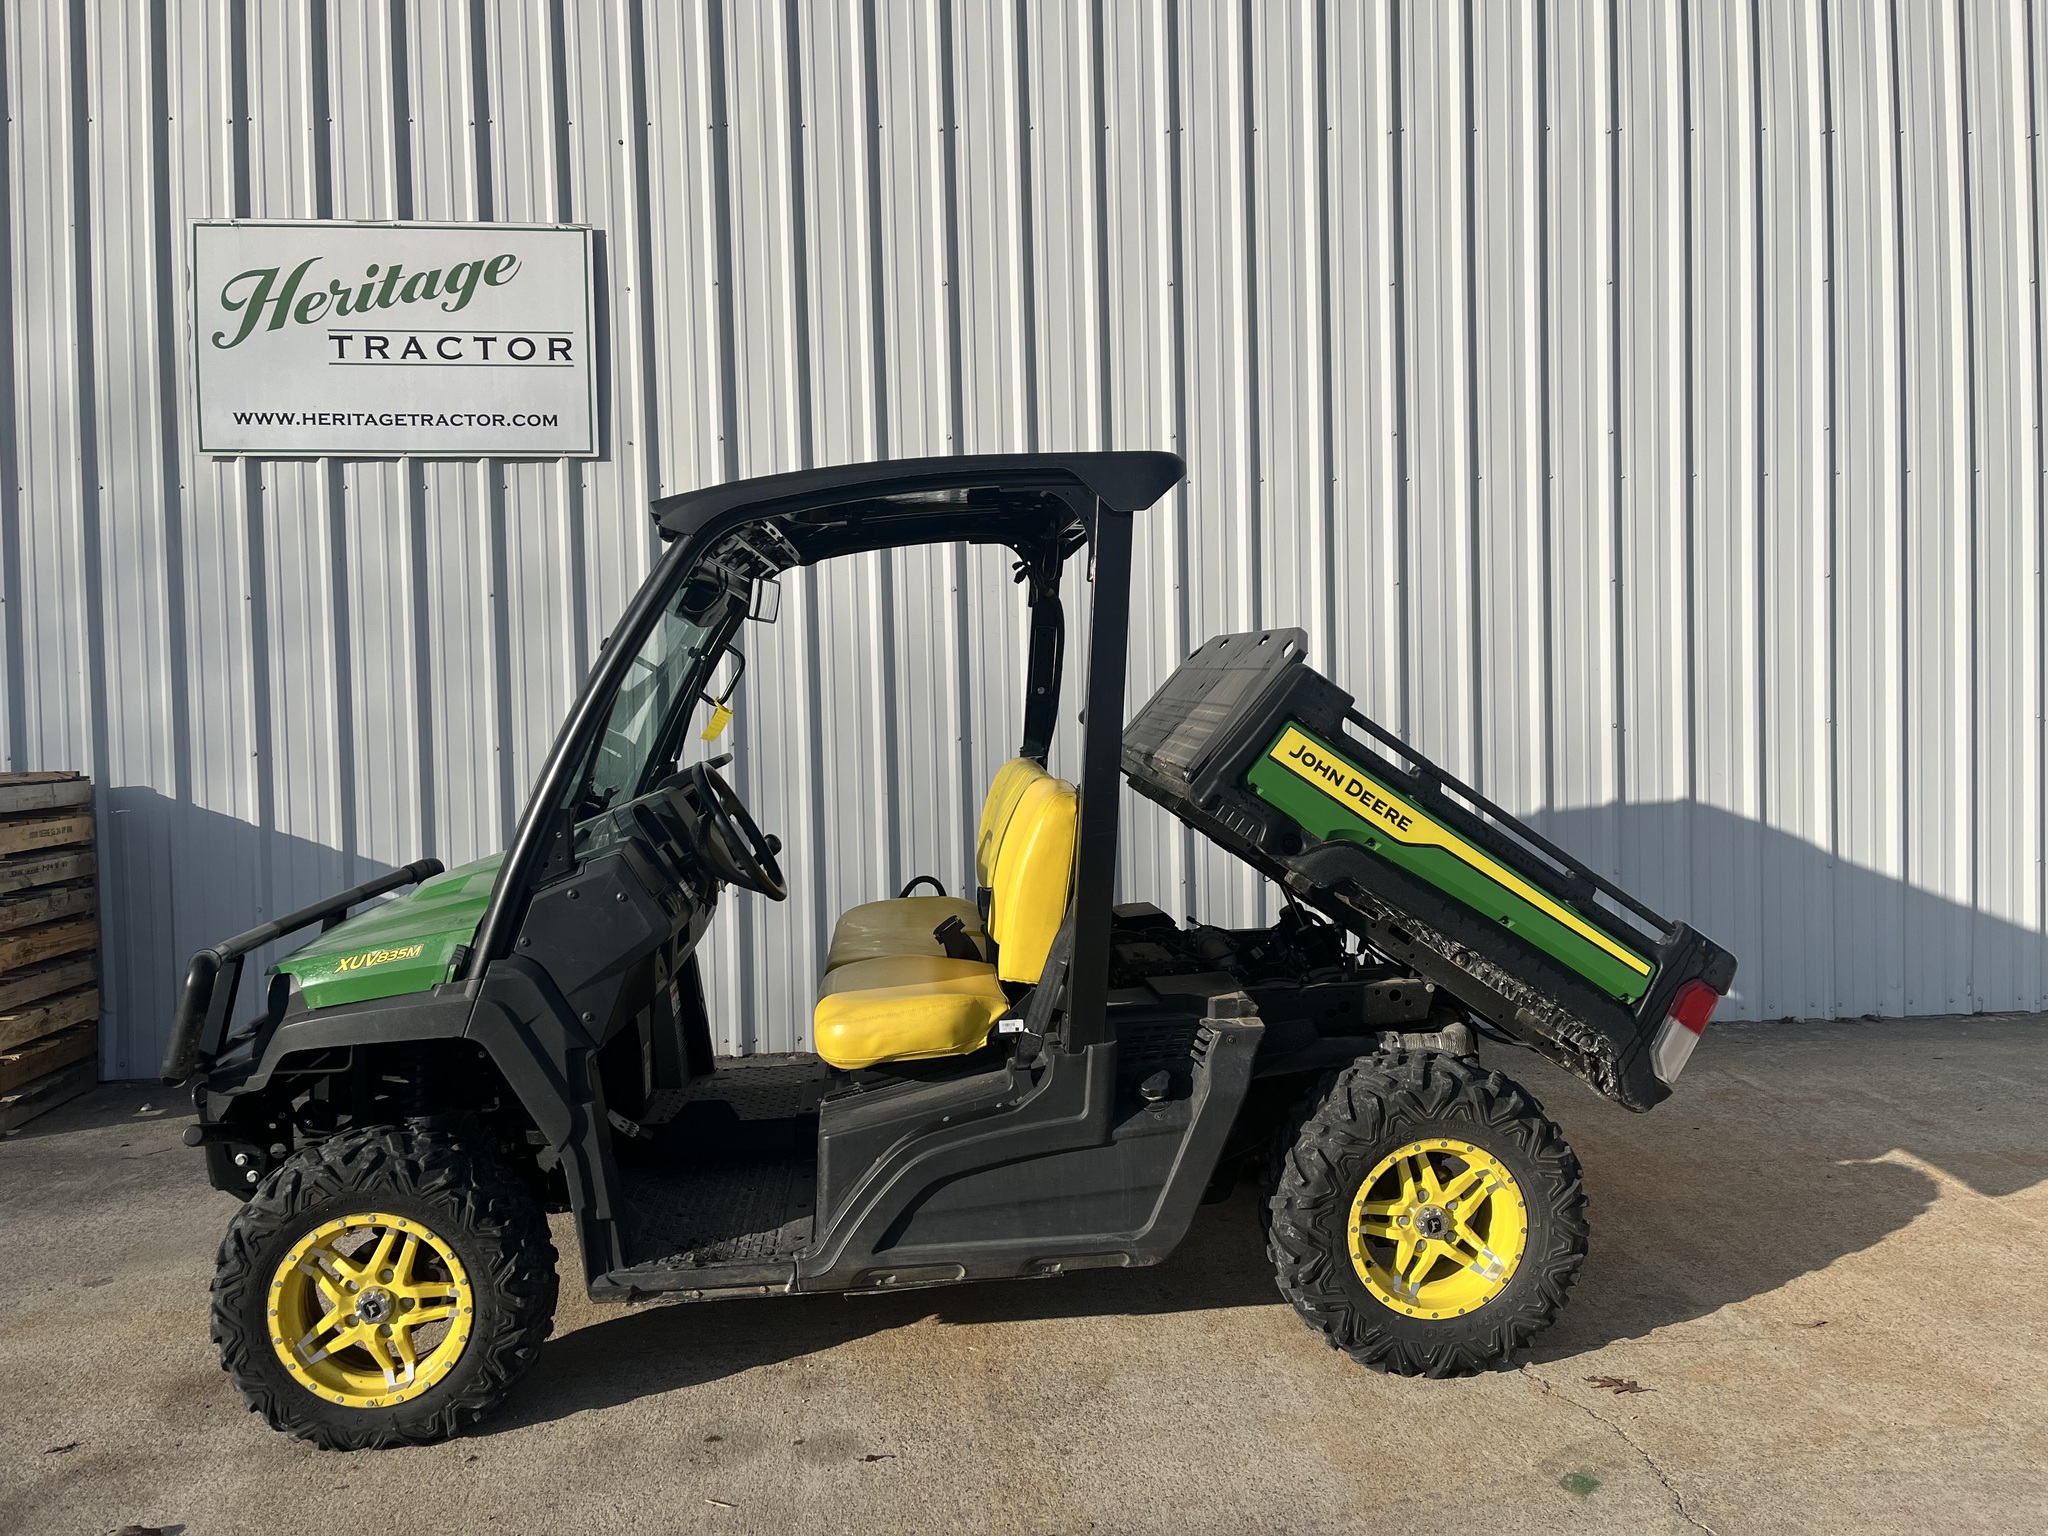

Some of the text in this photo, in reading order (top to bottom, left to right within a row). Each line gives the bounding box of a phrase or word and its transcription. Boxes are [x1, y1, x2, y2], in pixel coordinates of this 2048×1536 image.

[211, 253, 522, 349] Heritage
[328, 334, 573, 362] TRACTOR
[232, 412, 559, 427] WWW.HERITAGETRACTOR.COM
[1288, 745, 1413, 833] JOHN DEERE
[334, 944, 424, 974] XUV835M
